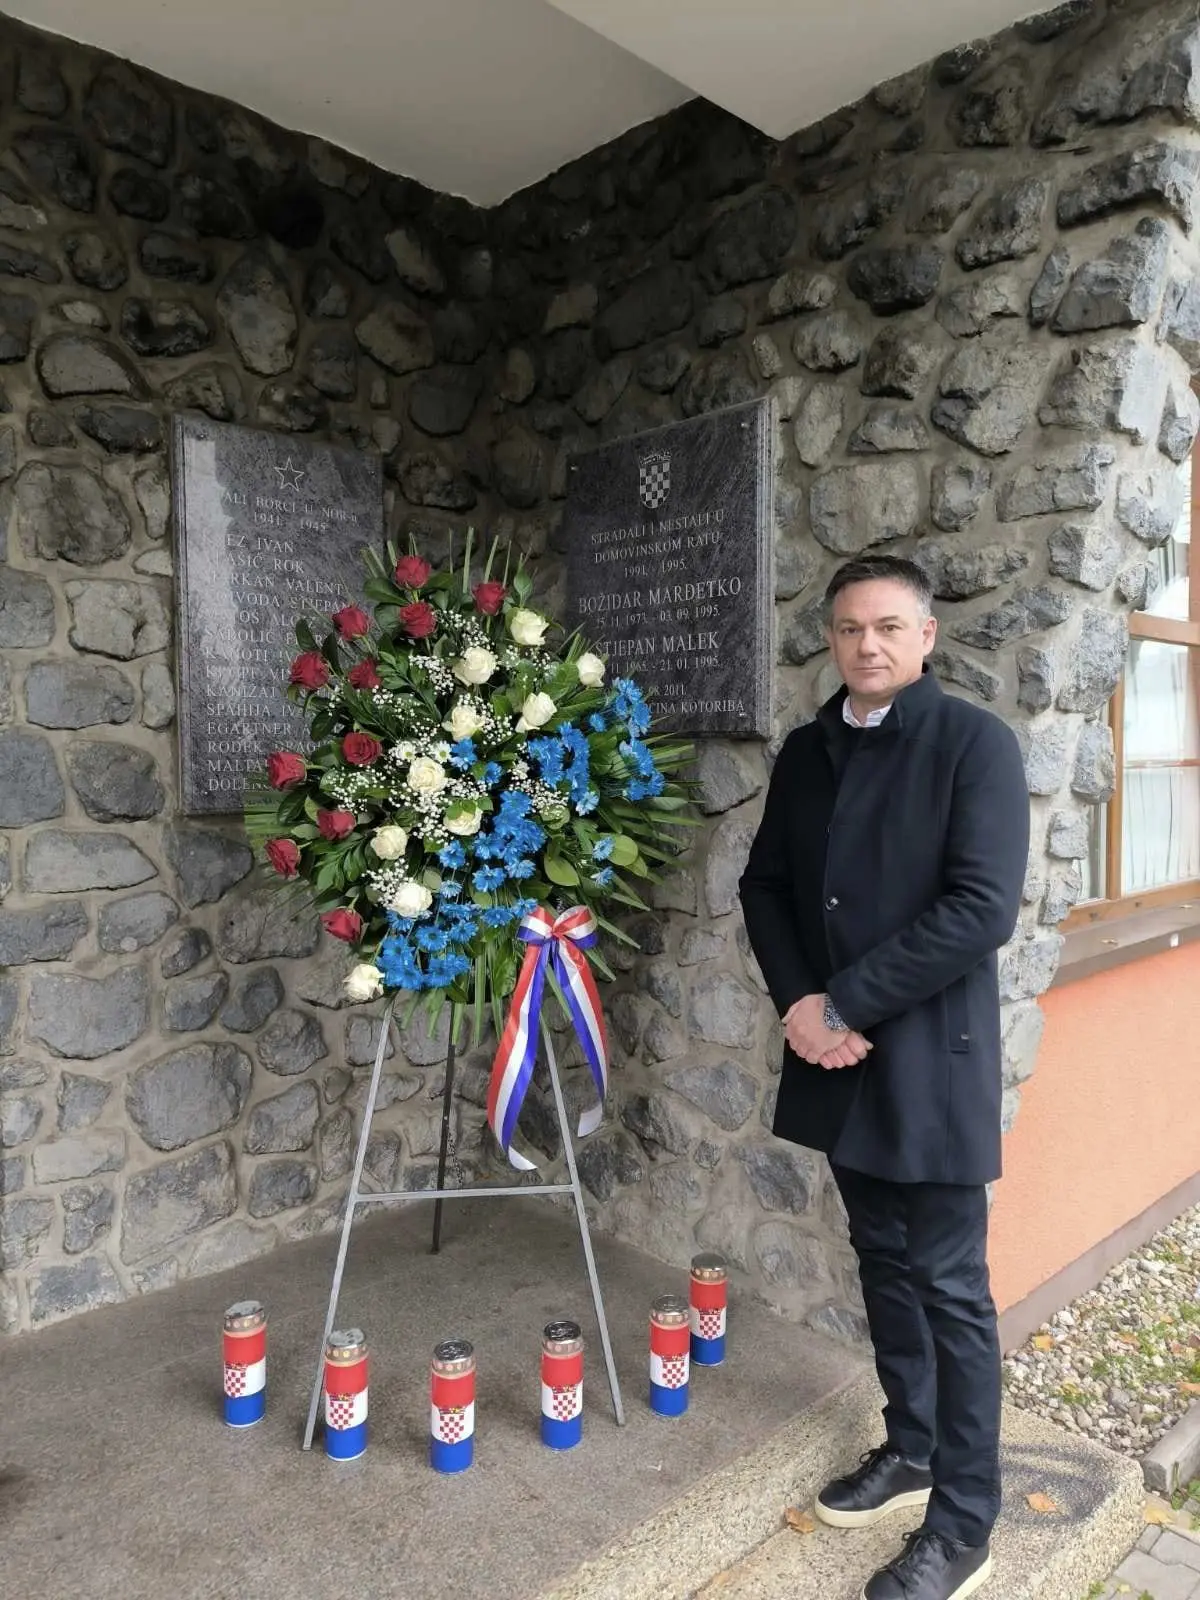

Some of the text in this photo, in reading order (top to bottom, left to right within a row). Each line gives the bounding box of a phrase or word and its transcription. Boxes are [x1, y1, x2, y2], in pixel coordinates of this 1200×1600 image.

[591, 509, 724, 545] STRADALI I NESTALI U
[257, 537, 294, 553] IVAN
[595, 531, 720, 564] DOMOVINSKOM RATU
[274, 558, 305, 574] ROK
[579, 590, 642, 614] BOŽIDAR
[663, 631, 719, 653] MALEK
[206, 703, 271, 717] SPAHIJA
[681, 699, 745, 713] KOTORIBA
[208, 722, 292, 735] EGARTNER
[208, 740, 263, 753] RODEK
